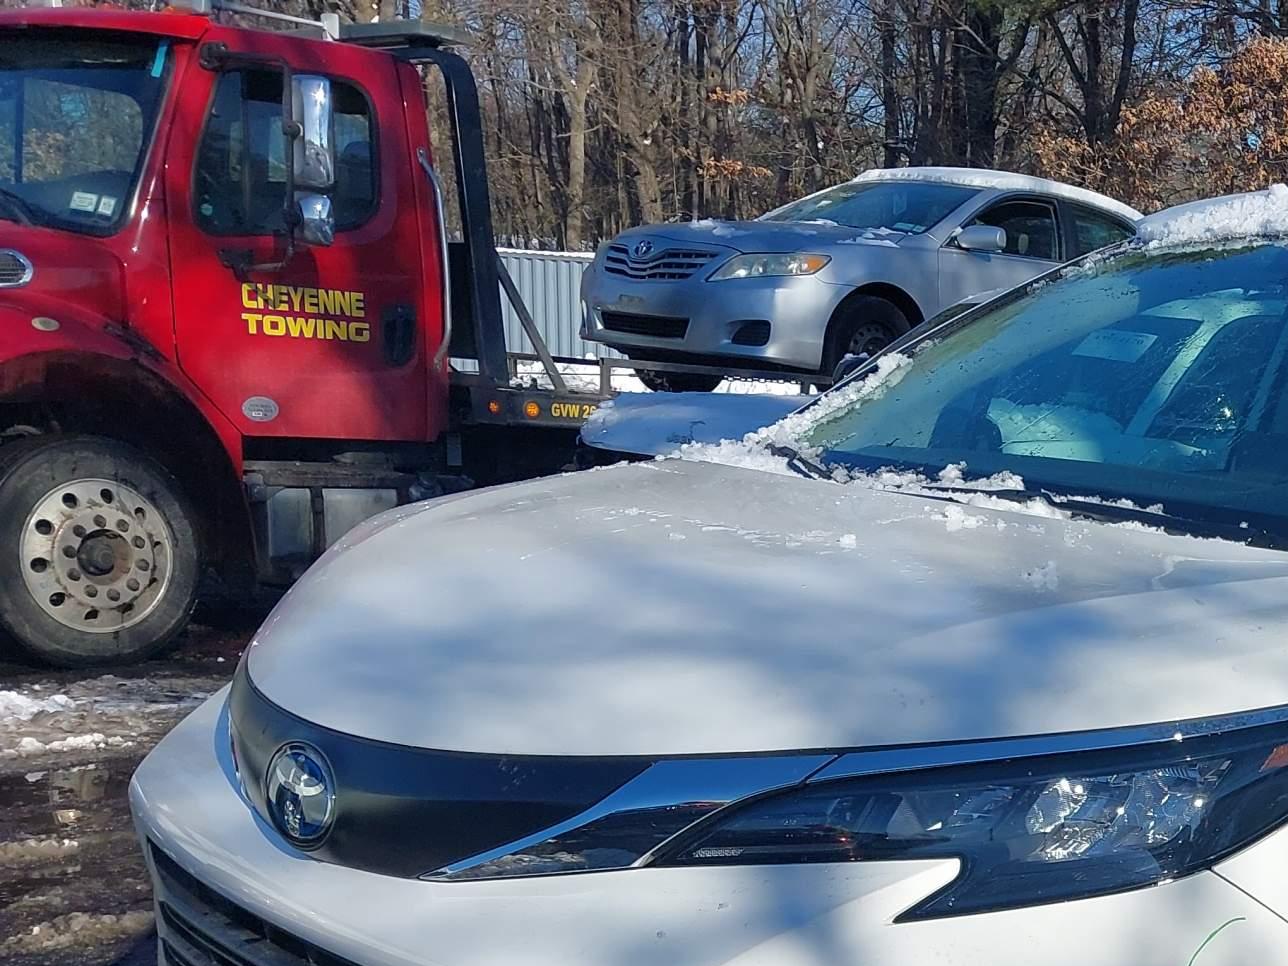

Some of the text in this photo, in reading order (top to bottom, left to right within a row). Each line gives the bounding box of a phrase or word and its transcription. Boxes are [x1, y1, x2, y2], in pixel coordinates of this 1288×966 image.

[241, 282, 365, 317] CHEYENNE
[241, 313, 370, 342] TOWING
[551, 403, 580, 417] GVW
